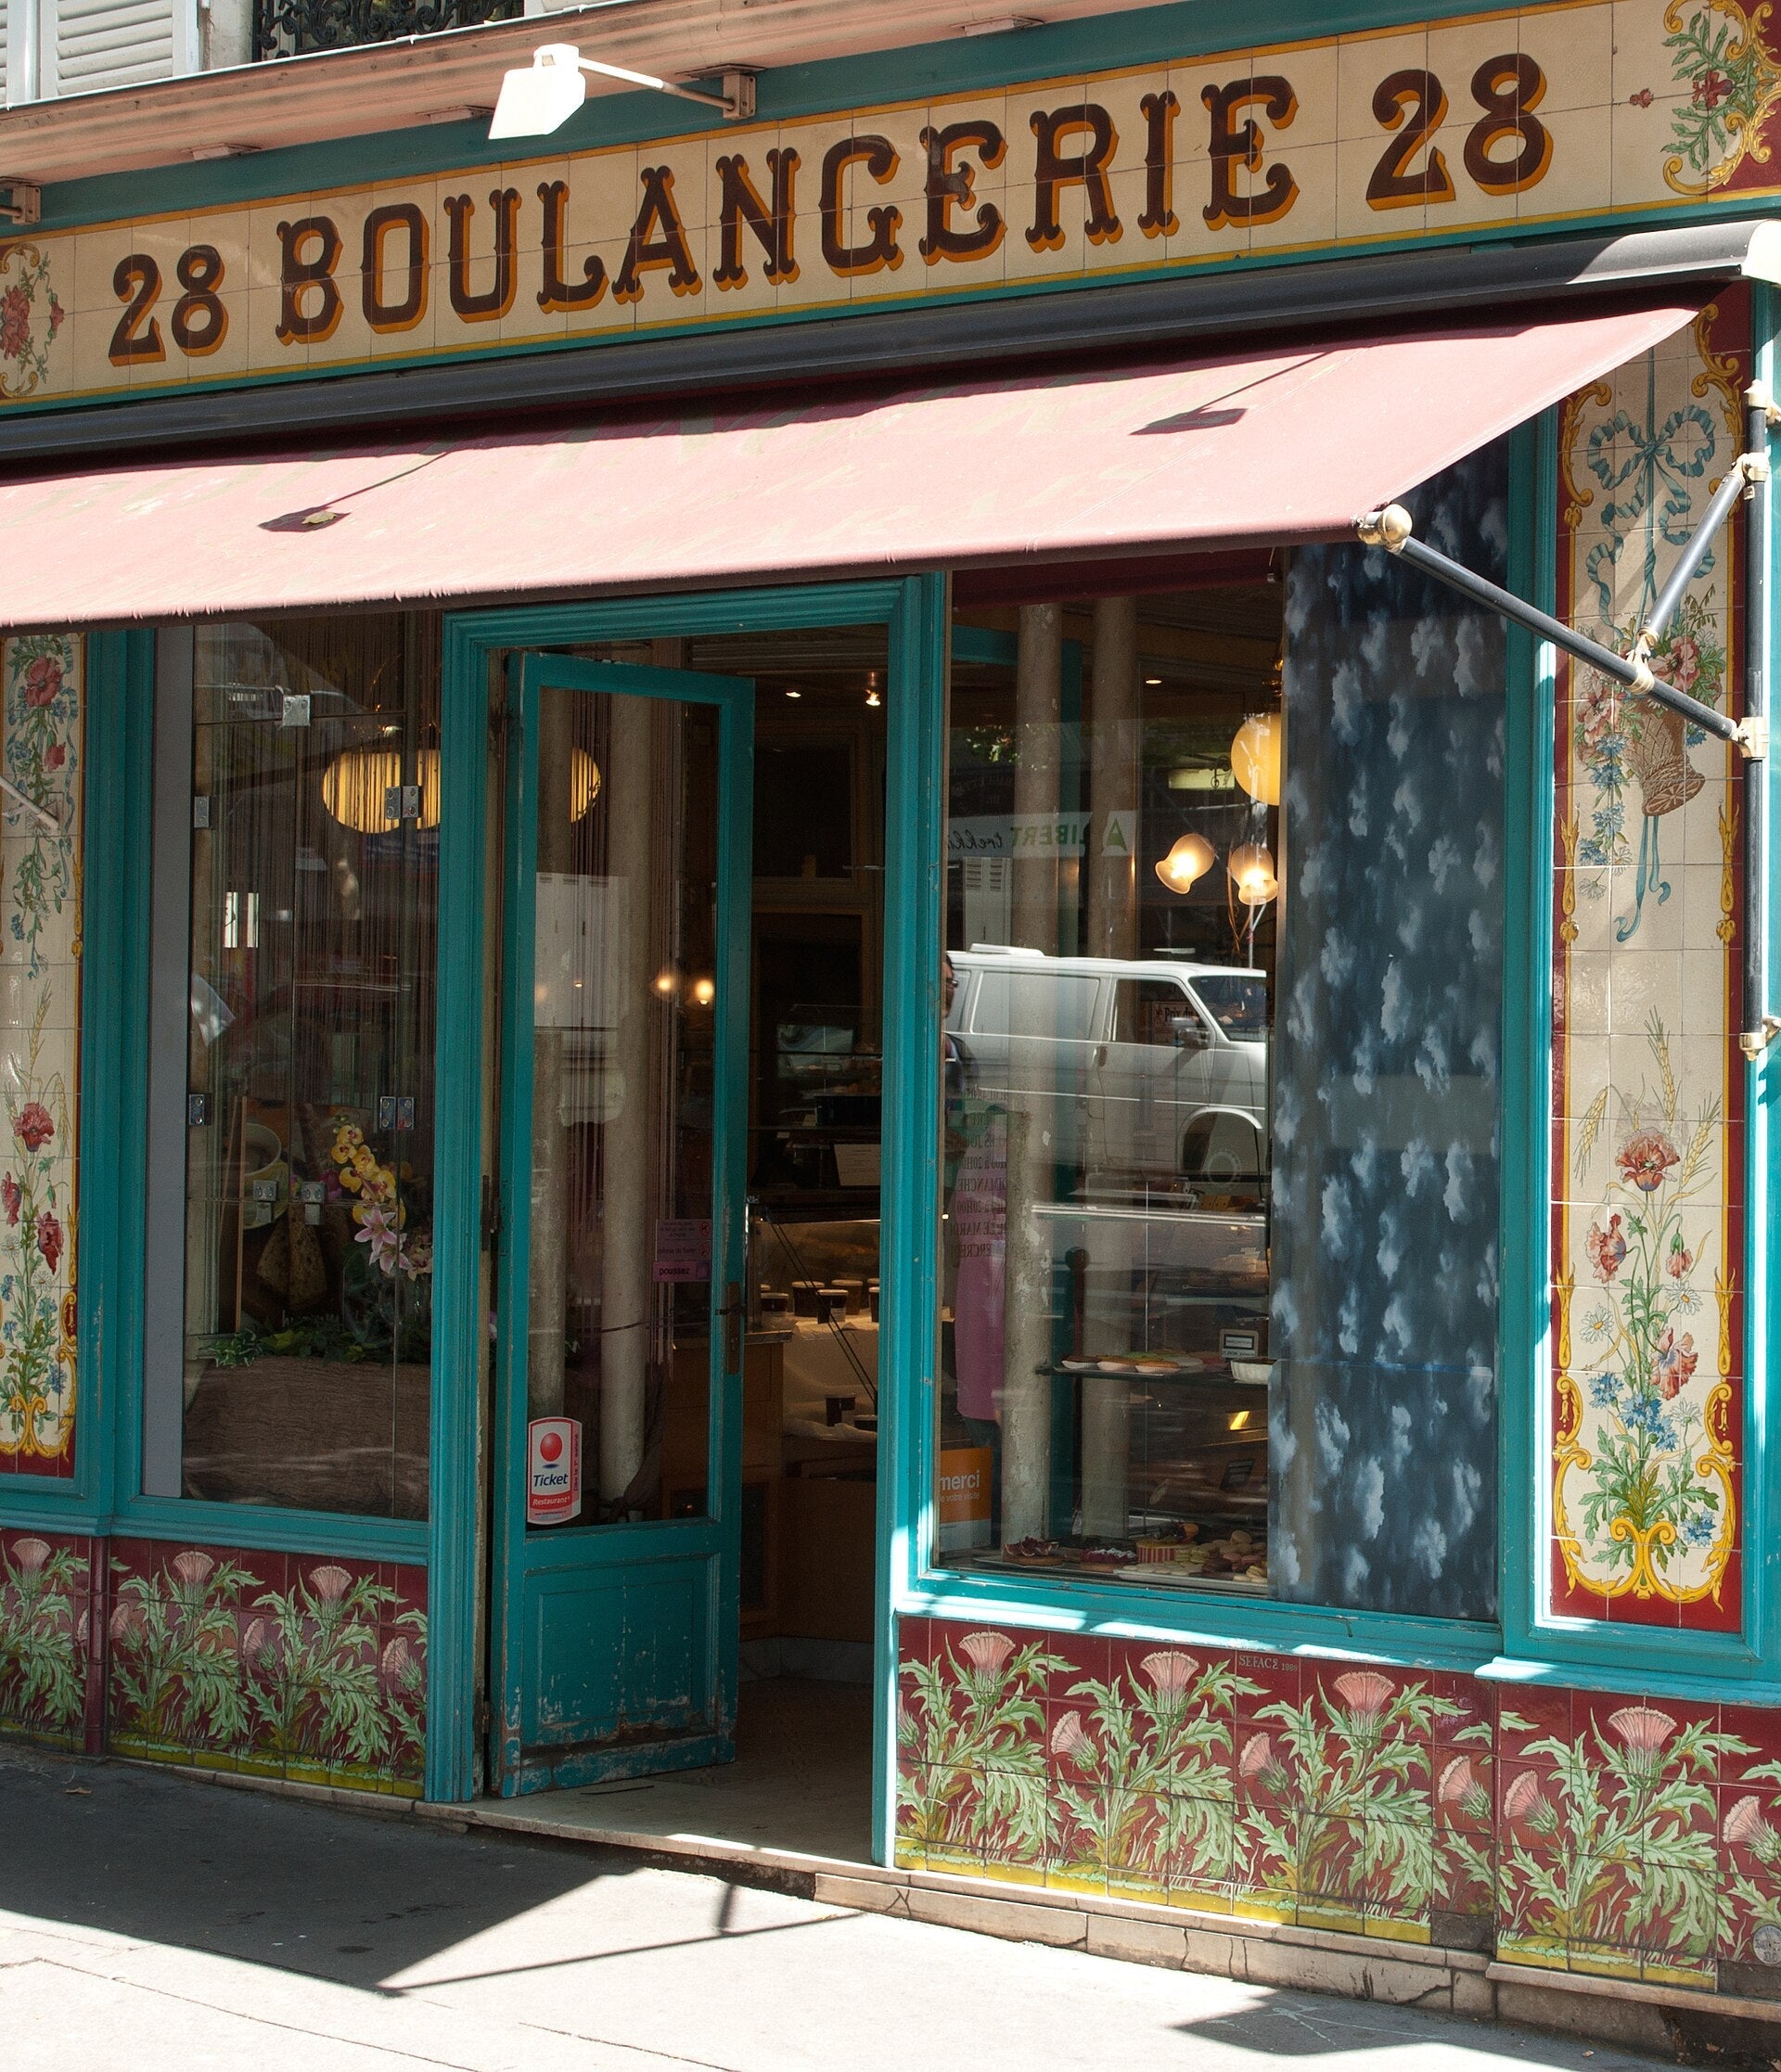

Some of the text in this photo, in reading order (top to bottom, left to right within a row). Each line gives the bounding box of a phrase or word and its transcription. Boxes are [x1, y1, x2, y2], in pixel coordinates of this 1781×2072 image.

[109, 53, 1554, 366] 28 BOULANGERIE 28
[660, 1267, 690, 1276] poussez
[533, 1474, 569, 1487] Ticket
